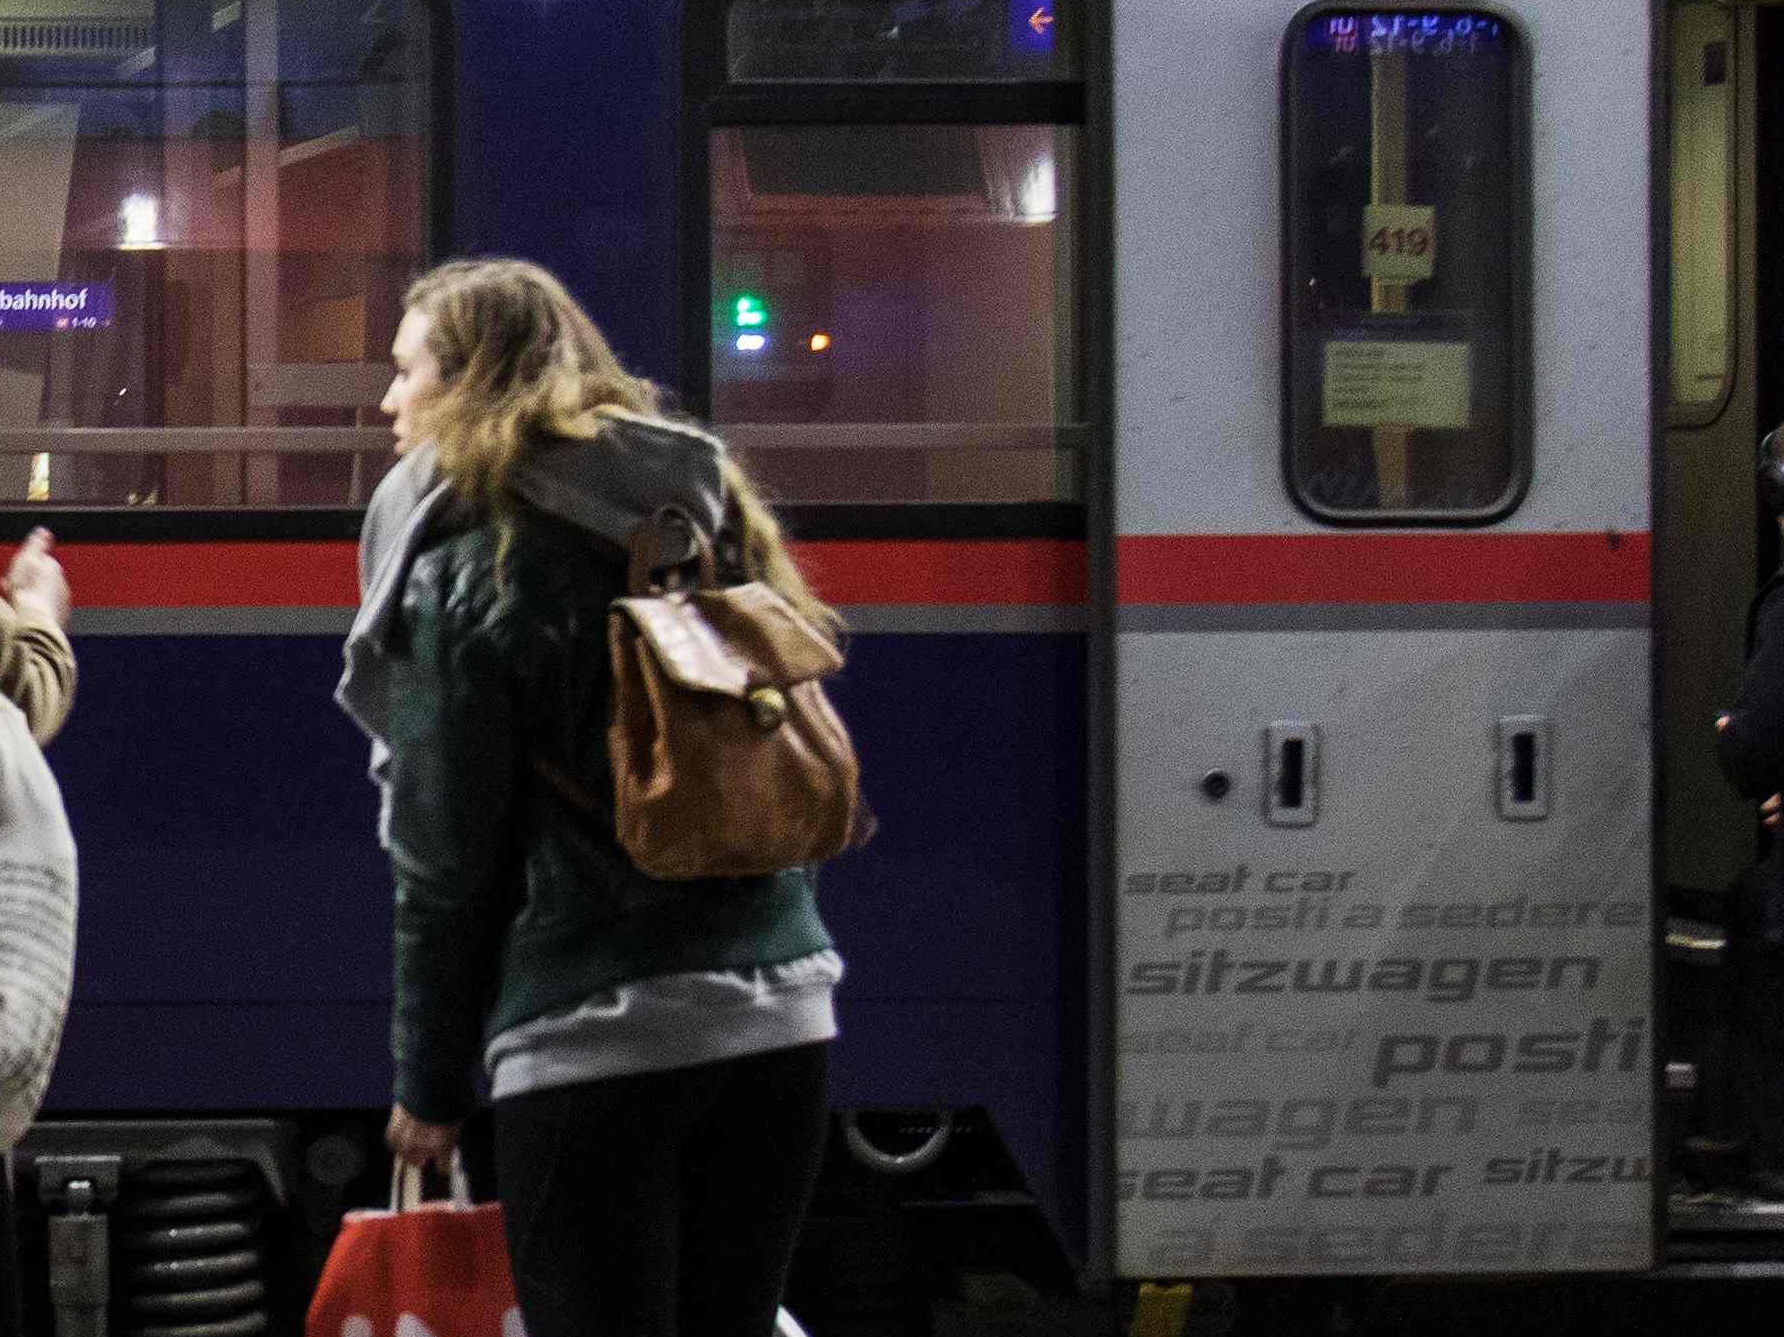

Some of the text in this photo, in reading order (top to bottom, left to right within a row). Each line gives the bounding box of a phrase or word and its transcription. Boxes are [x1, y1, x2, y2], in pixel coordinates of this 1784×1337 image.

[1371, 229, 1429, 255] 419
[1124, 865, 1357, 895] seat car
[1164, 895, 1646, 938] posti a sedere
[1126, 949, 1604, 1003] sitzwagen
[1372, 1017, 1647, 1088] posti
[1308, 1162, 1452, 1200] car
